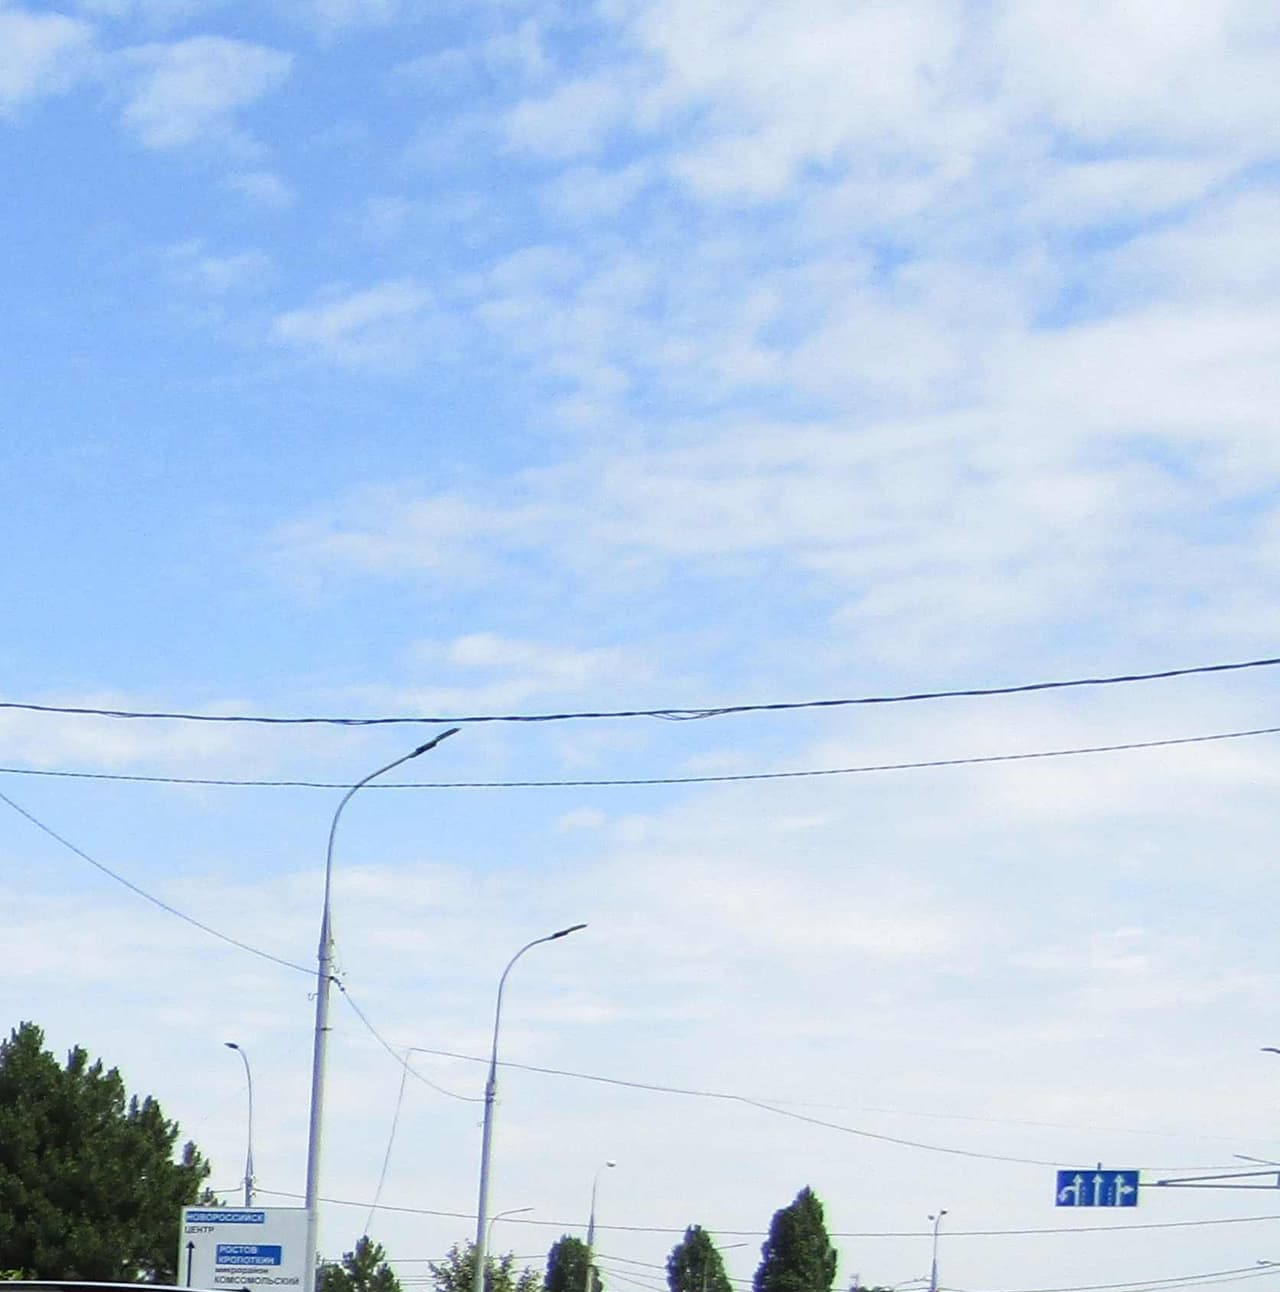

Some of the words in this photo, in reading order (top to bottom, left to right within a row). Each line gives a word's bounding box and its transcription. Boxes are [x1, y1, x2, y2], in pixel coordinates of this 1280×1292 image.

[184, 1226, 215, 1234] ЦЕНТР
[219, 1246, 258, 1255] РОСТОВ
[218, 1256, 275, 1265] КРОПОТКИН
[214, 1276, 300, 1286] КОМСОМОЛЬСКИЙ
